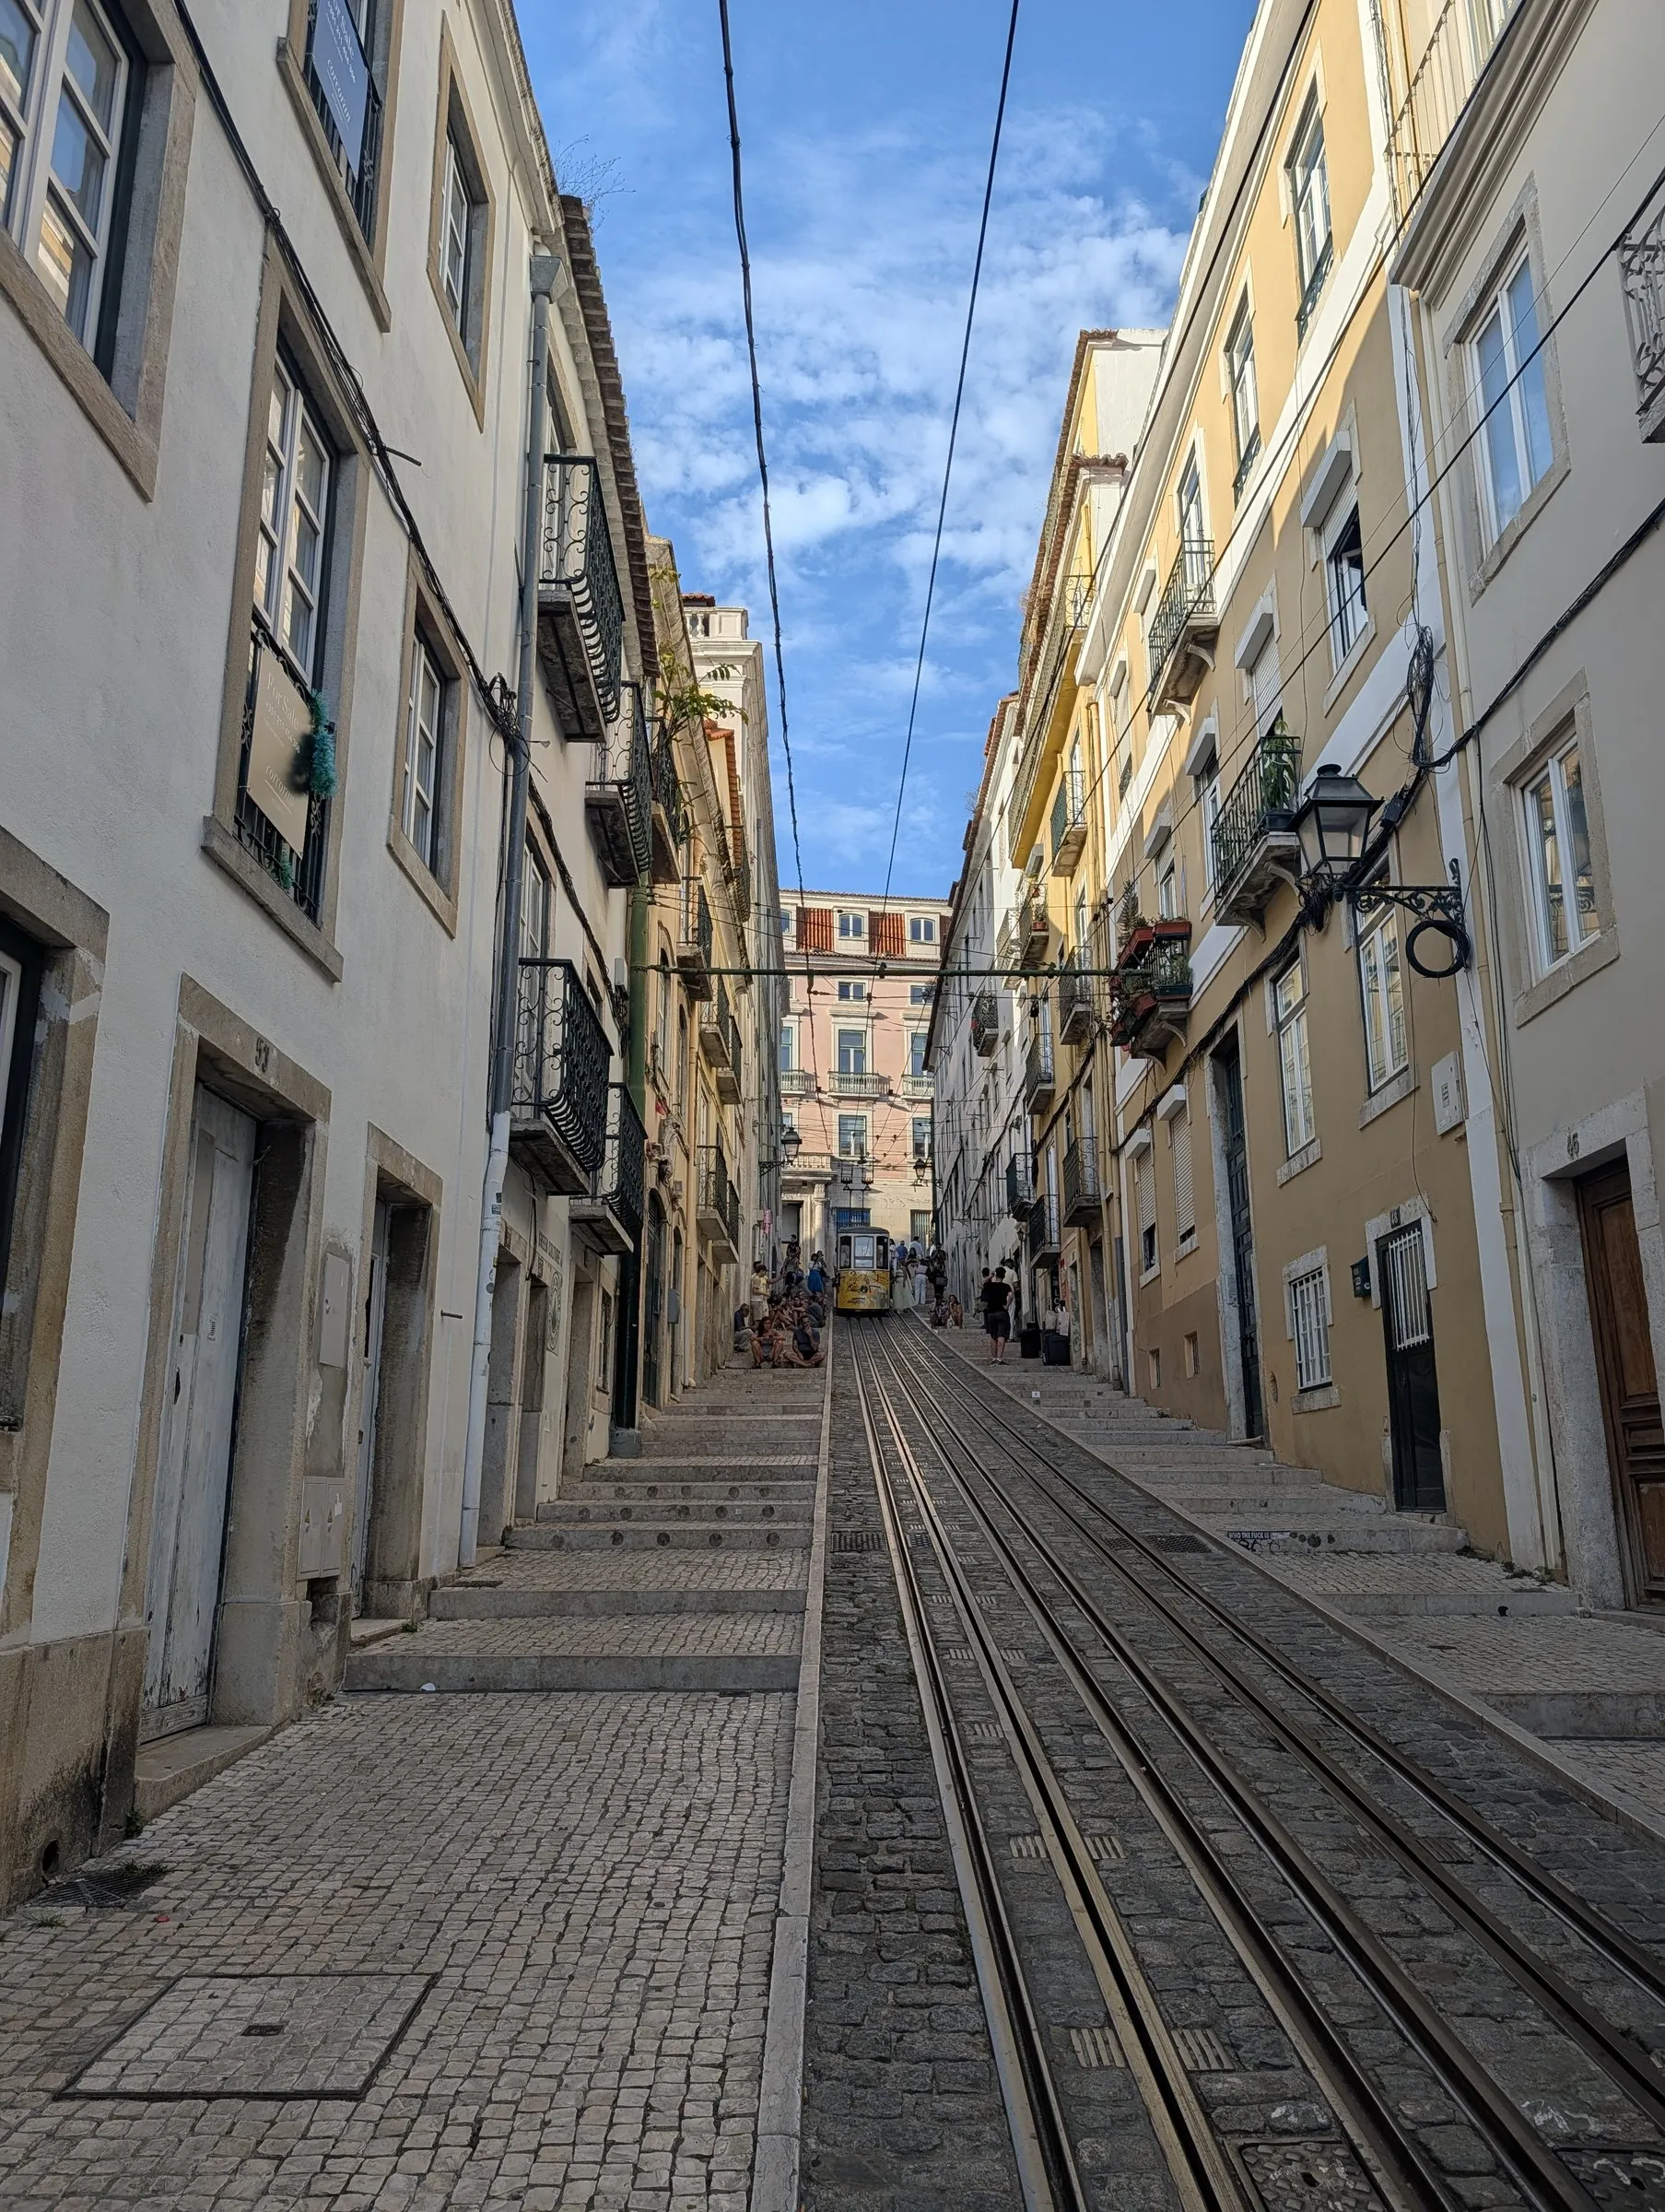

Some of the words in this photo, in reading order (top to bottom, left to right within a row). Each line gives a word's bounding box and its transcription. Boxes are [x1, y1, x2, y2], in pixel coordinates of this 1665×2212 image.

[341, 15, 354, 60] Sale
[327, 59, 351, 123] corcoran
[266, 673, 284, 705] For
[282, 696, 299, 731] Sale
[265, 765, 295, 807] corcoran
[255, 1036, 269, 1073] 53
[1567, 1132, 1579, 1157] 46
